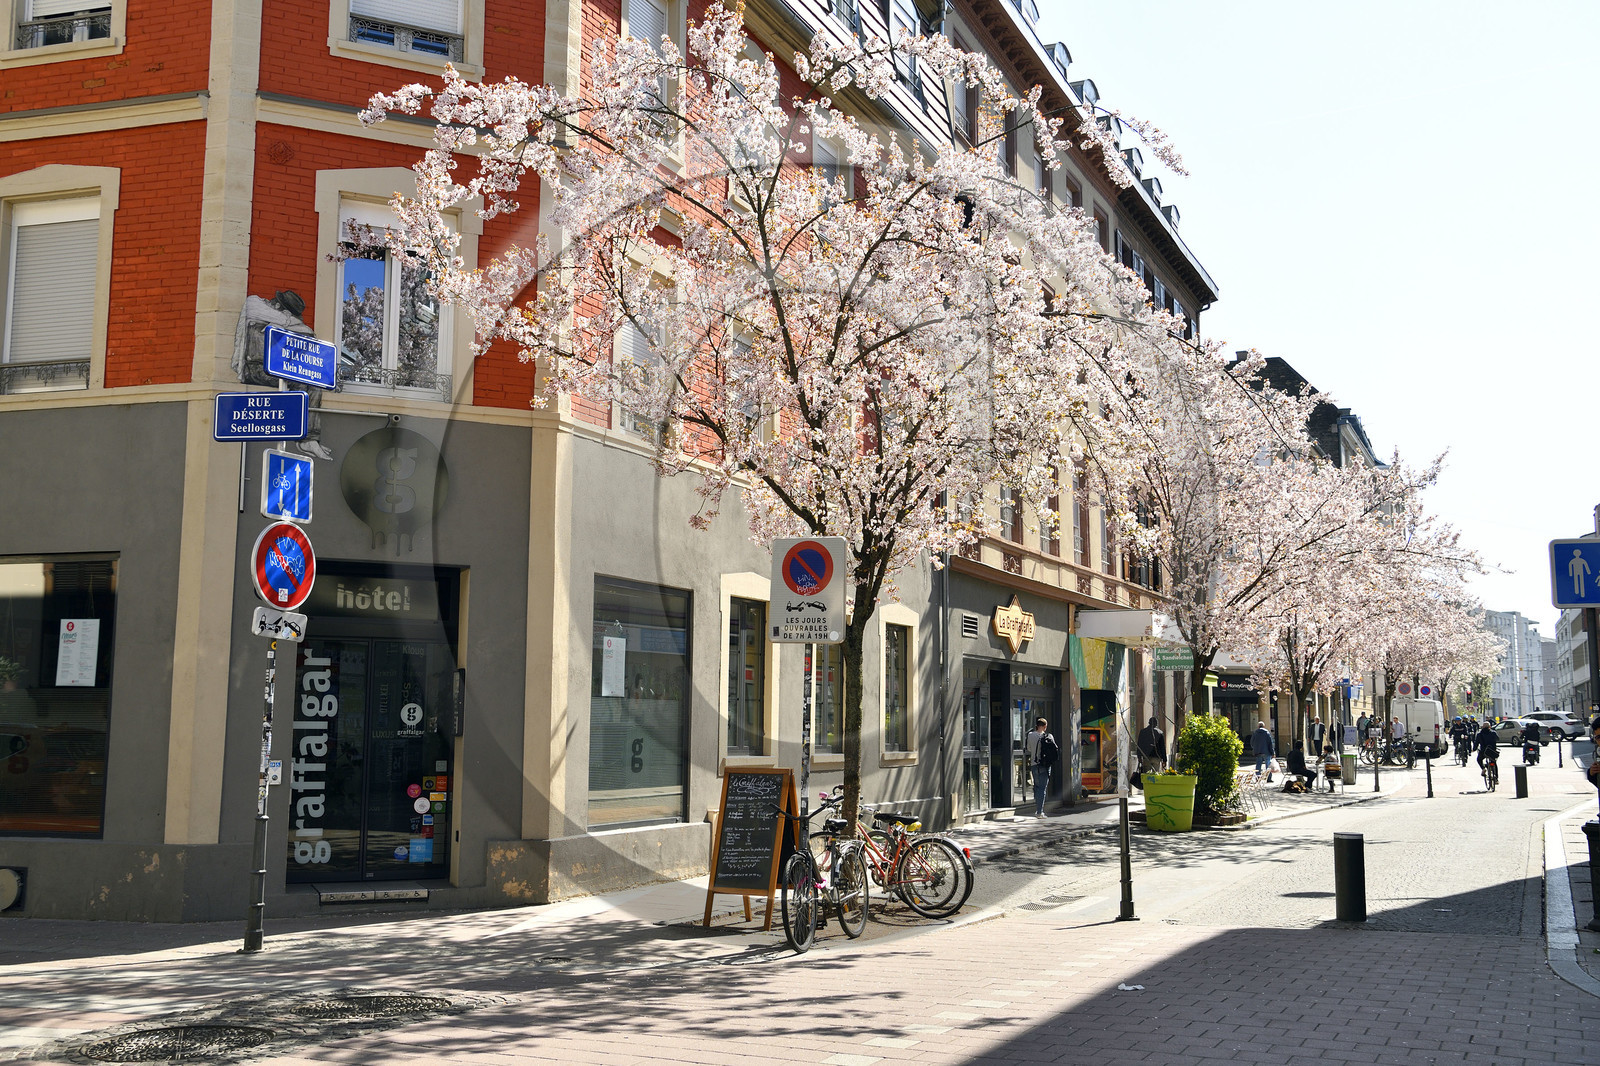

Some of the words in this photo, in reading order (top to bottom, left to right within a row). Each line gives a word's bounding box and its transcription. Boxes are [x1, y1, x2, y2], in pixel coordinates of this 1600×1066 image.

[286, 336, 307, 351] PETITE
[308, 342, 320, 354] RUE
[282, 348, 290, 358] DE
[291, 350, 300, 361] LA
[300, 353, 324, 367] COURSE
[283, 362, 297, 372] Klein
[298, 365, 322, 380] Renngass
[248, 398, 271, 406] RUE
[233, 408, 285, 420] DÉSERTE
[230, 423, 286, 434] Seellosgass
[999, 614, 1005, 628] La
[1006, 616, 1032, 633] Graffateria
[290, 648, 338, 864] graffalgar
